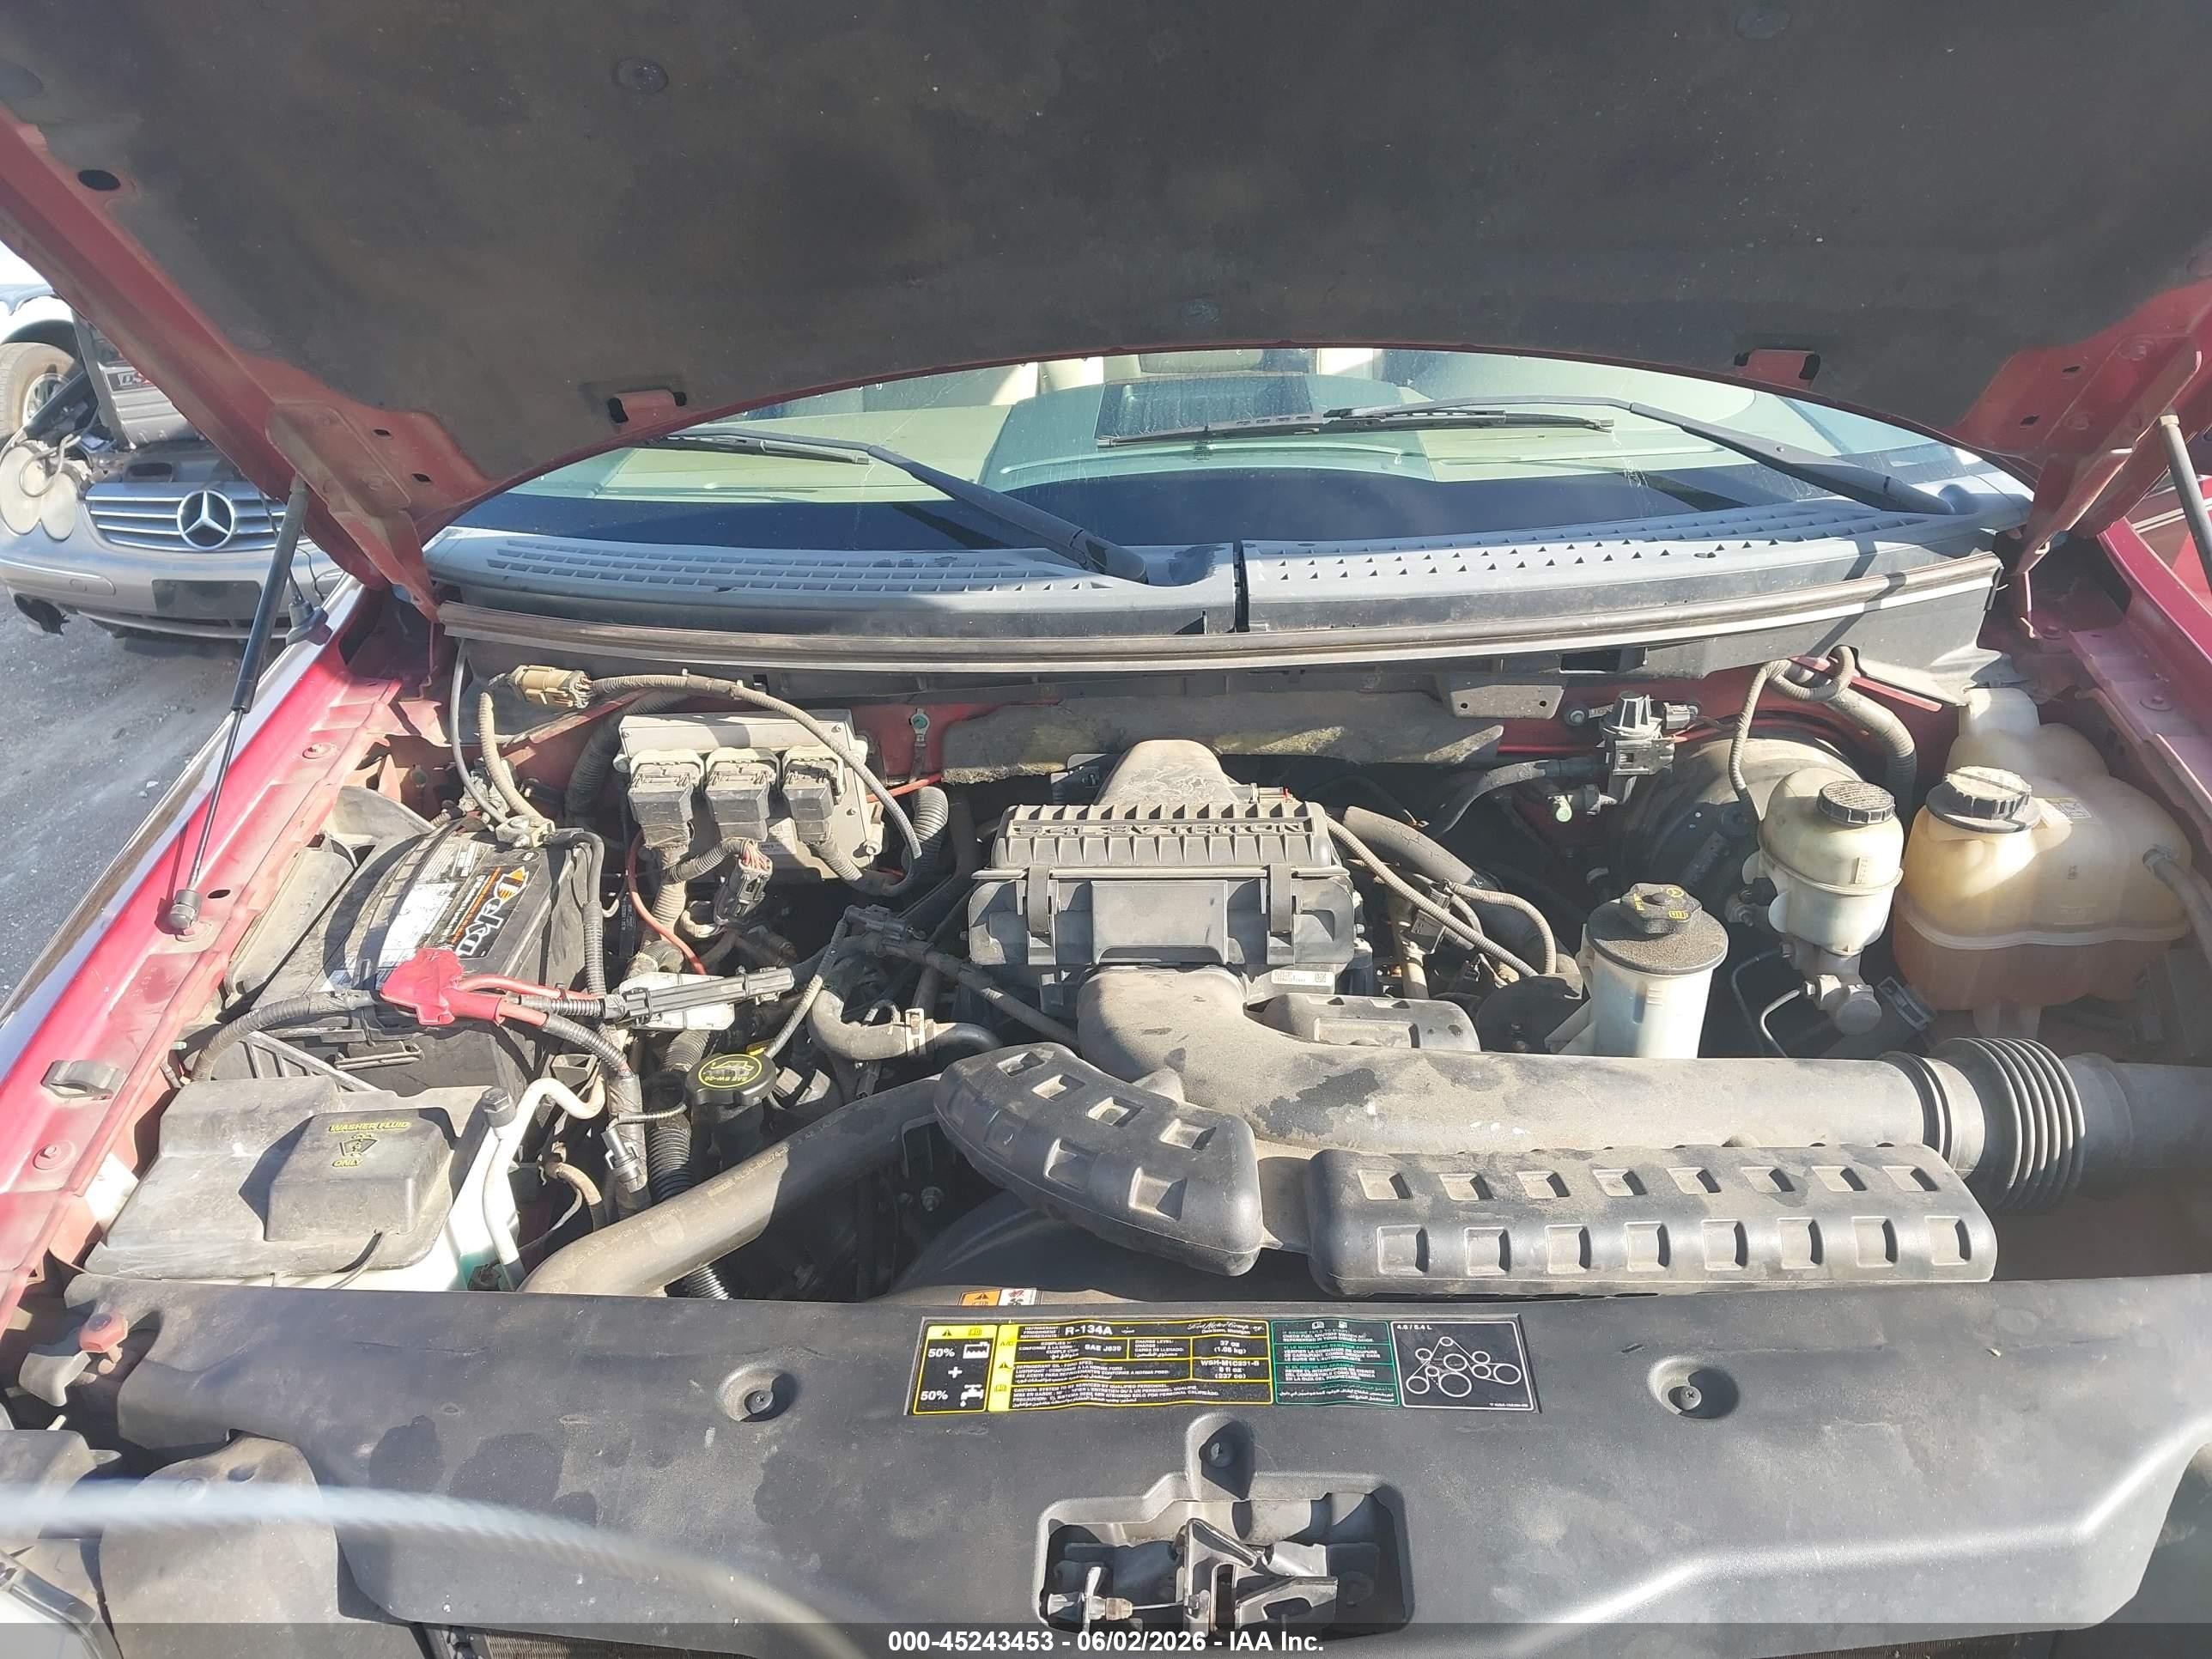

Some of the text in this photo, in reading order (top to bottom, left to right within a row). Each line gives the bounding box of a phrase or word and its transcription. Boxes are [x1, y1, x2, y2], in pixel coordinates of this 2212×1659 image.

[1172, 823, 1304, 834] TRITON
[329, 1121, 411, 1133] WASHER FLUID
[332, 1158, 363, 1168] ONLY
[1065, 1325, 1113, 1335] R-134A
[927, 1348, 955, 1358] 50%
[921, 1389, 949, 1401] 50%
